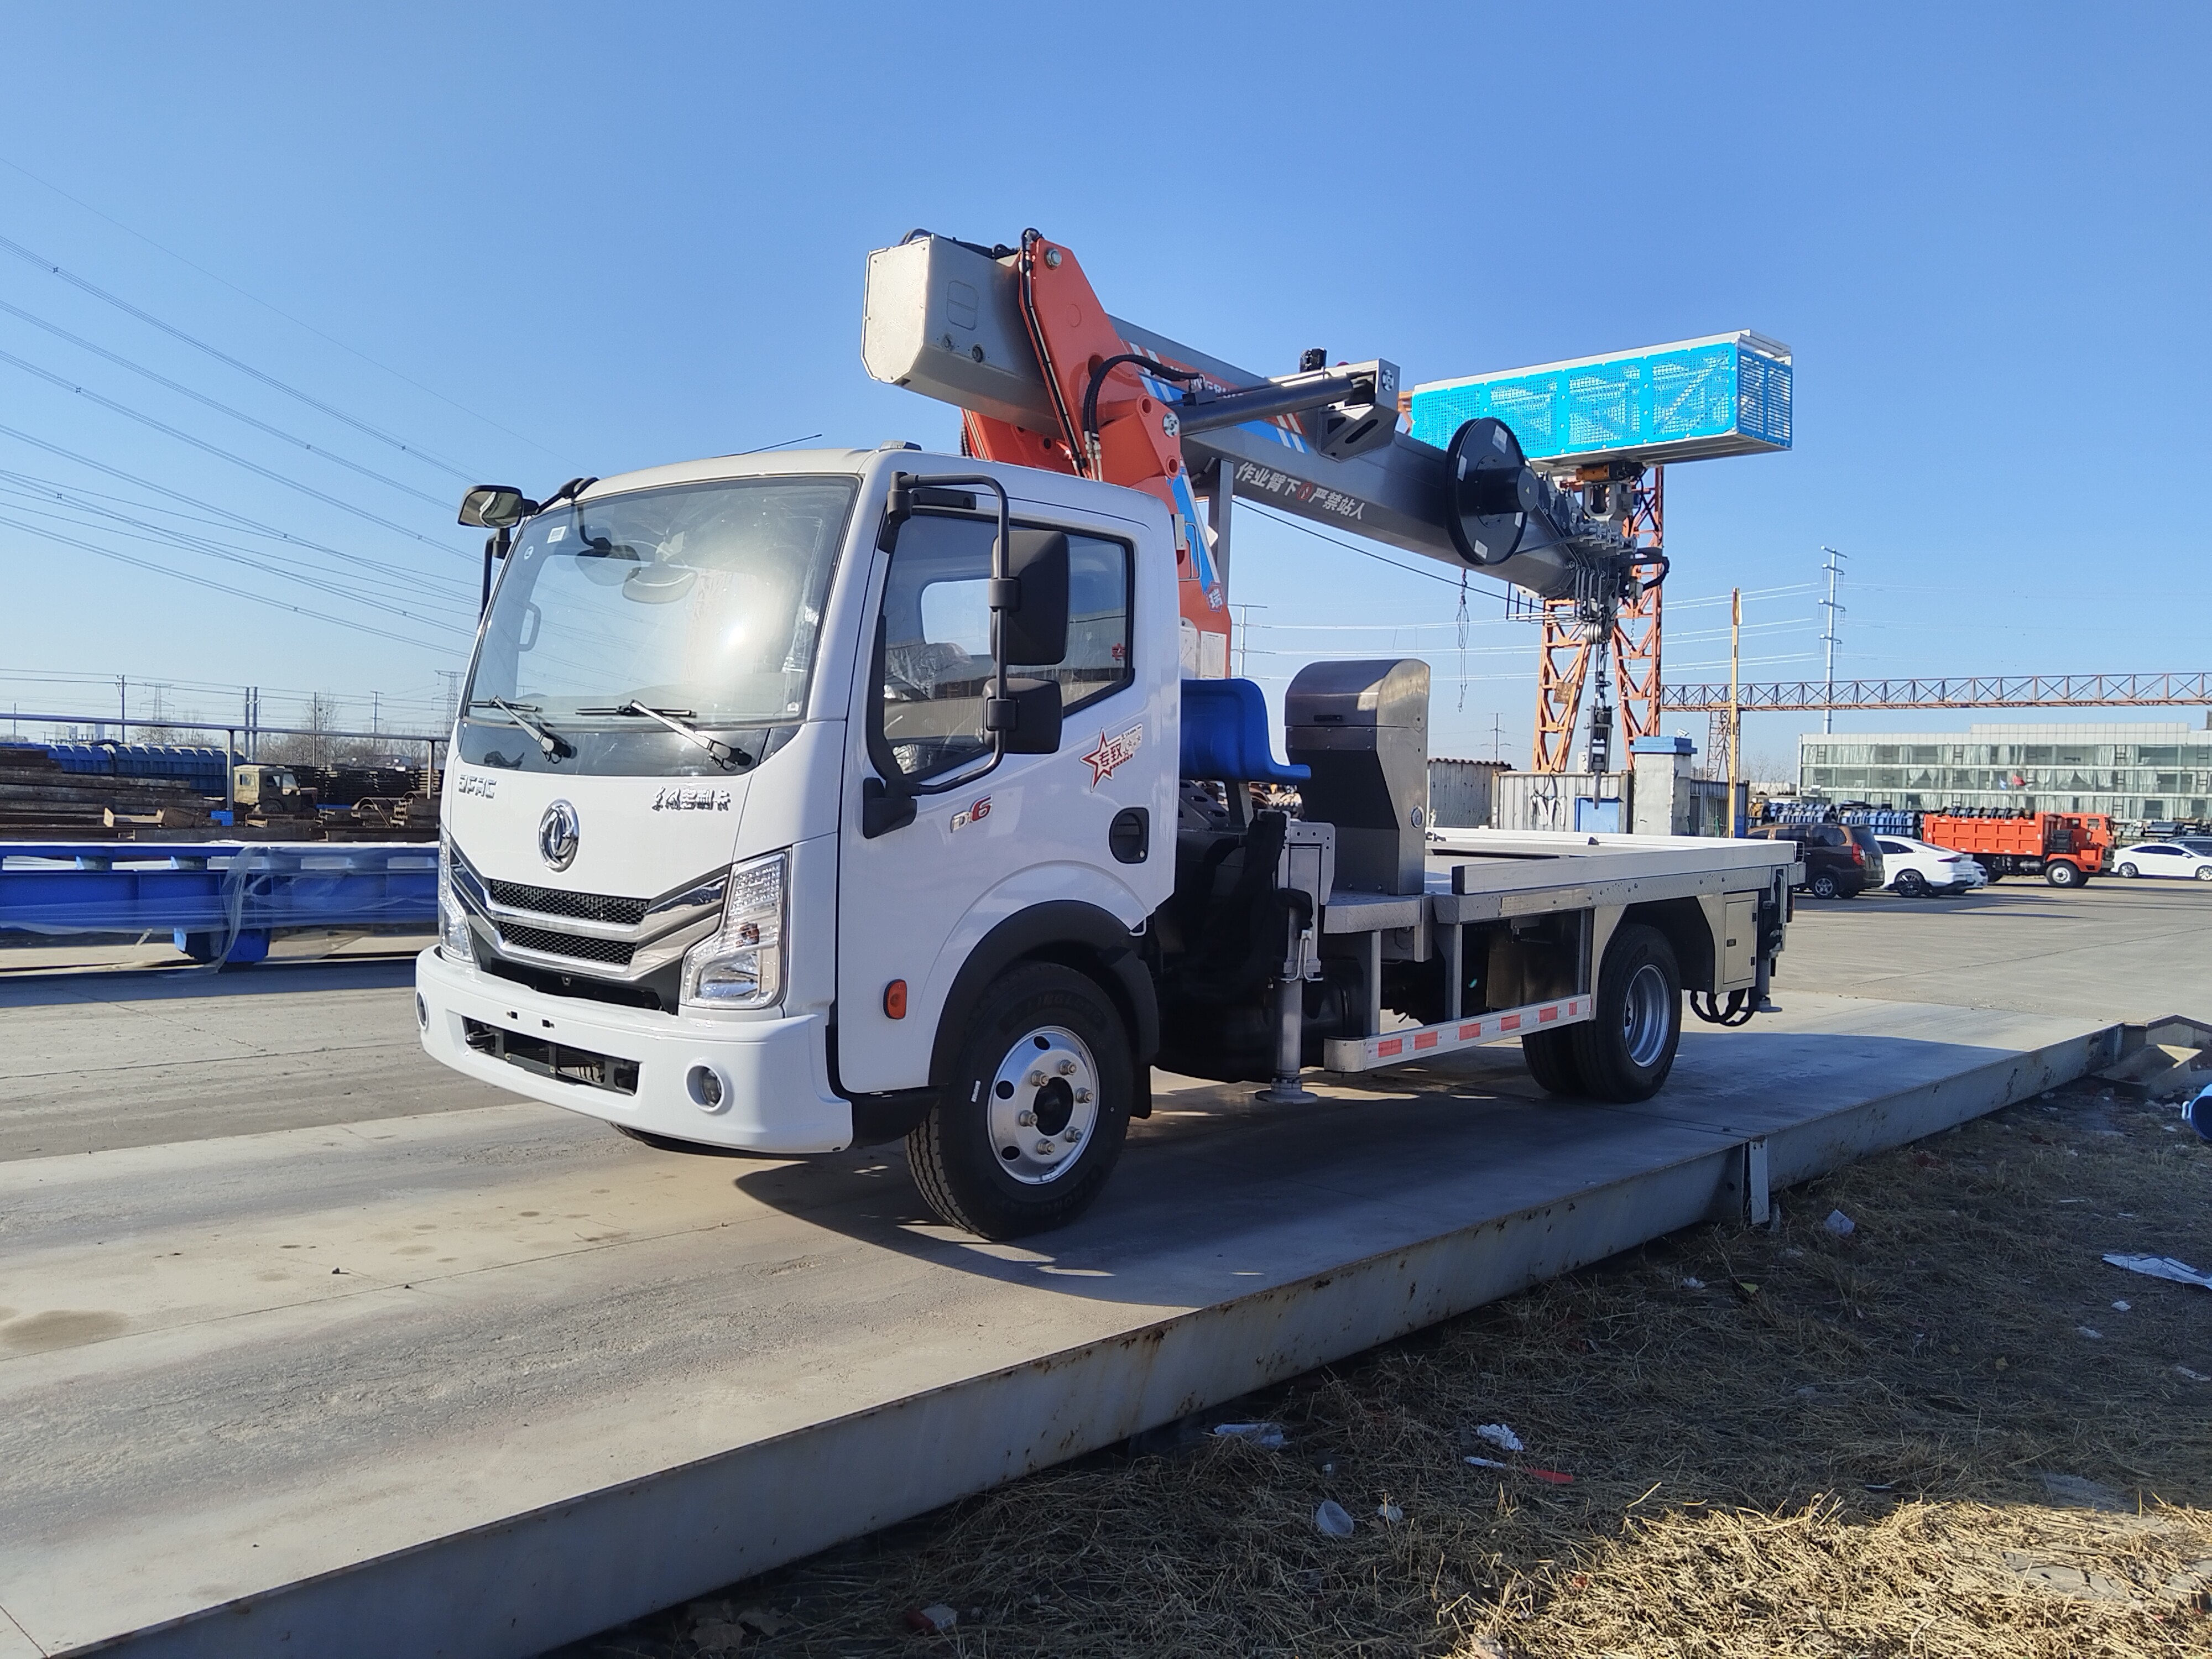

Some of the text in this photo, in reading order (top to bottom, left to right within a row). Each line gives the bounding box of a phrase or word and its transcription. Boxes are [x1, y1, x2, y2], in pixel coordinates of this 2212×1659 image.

[1235, 462, 1365, 520] 作业臂下 严禁站人
[458, 774, 497, 799] DFAC
